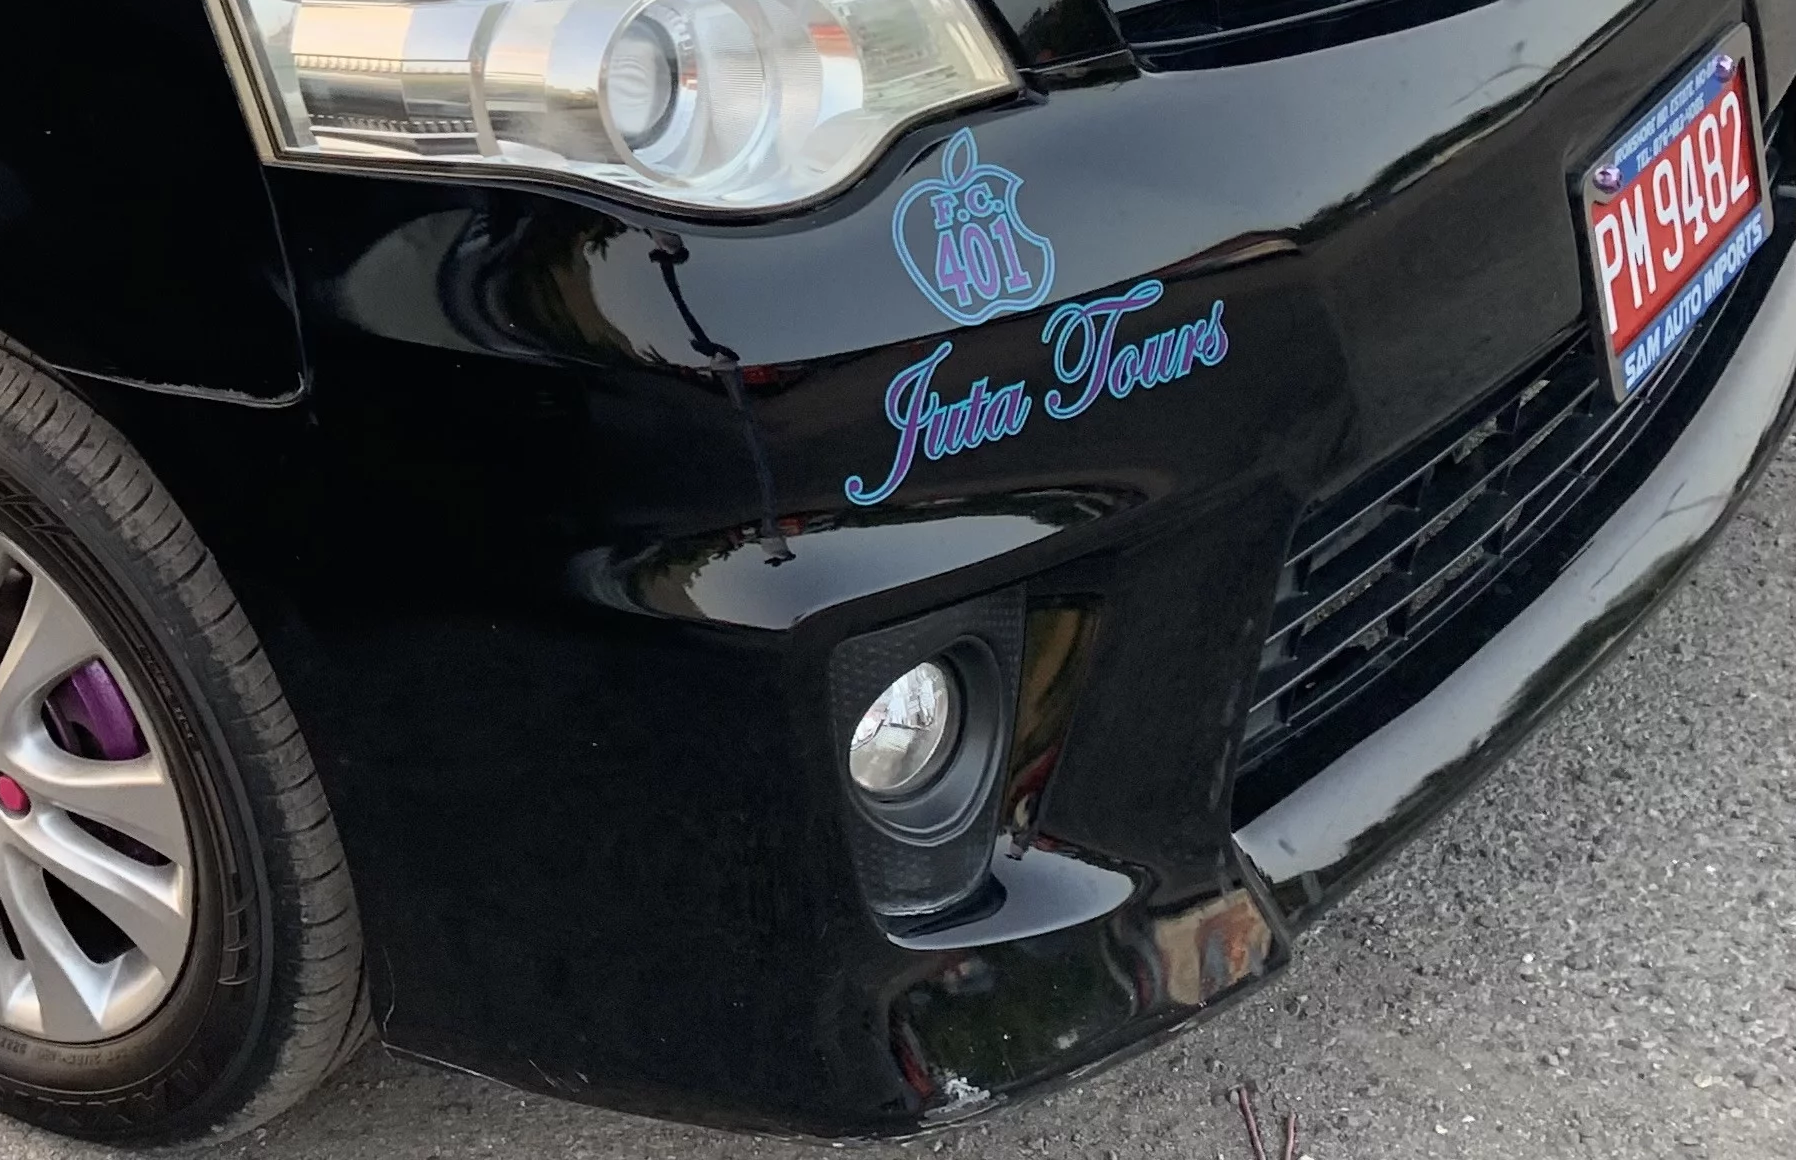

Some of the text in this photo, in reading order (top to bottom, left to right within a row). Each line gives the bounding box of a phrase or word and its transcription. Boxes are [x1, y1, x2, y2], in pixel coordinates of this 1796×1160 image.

[930, 182, 1005, 230] F.C.
[935, 213, 1032, 307] 401
[1594, 184, 1657, 335] PM
[1652, 91, 1750, 272] 9482
[1624, 213, 1763, 391] SAM AUTO IMPORTS
[844, 279, 1230, 506] Juta Tours
